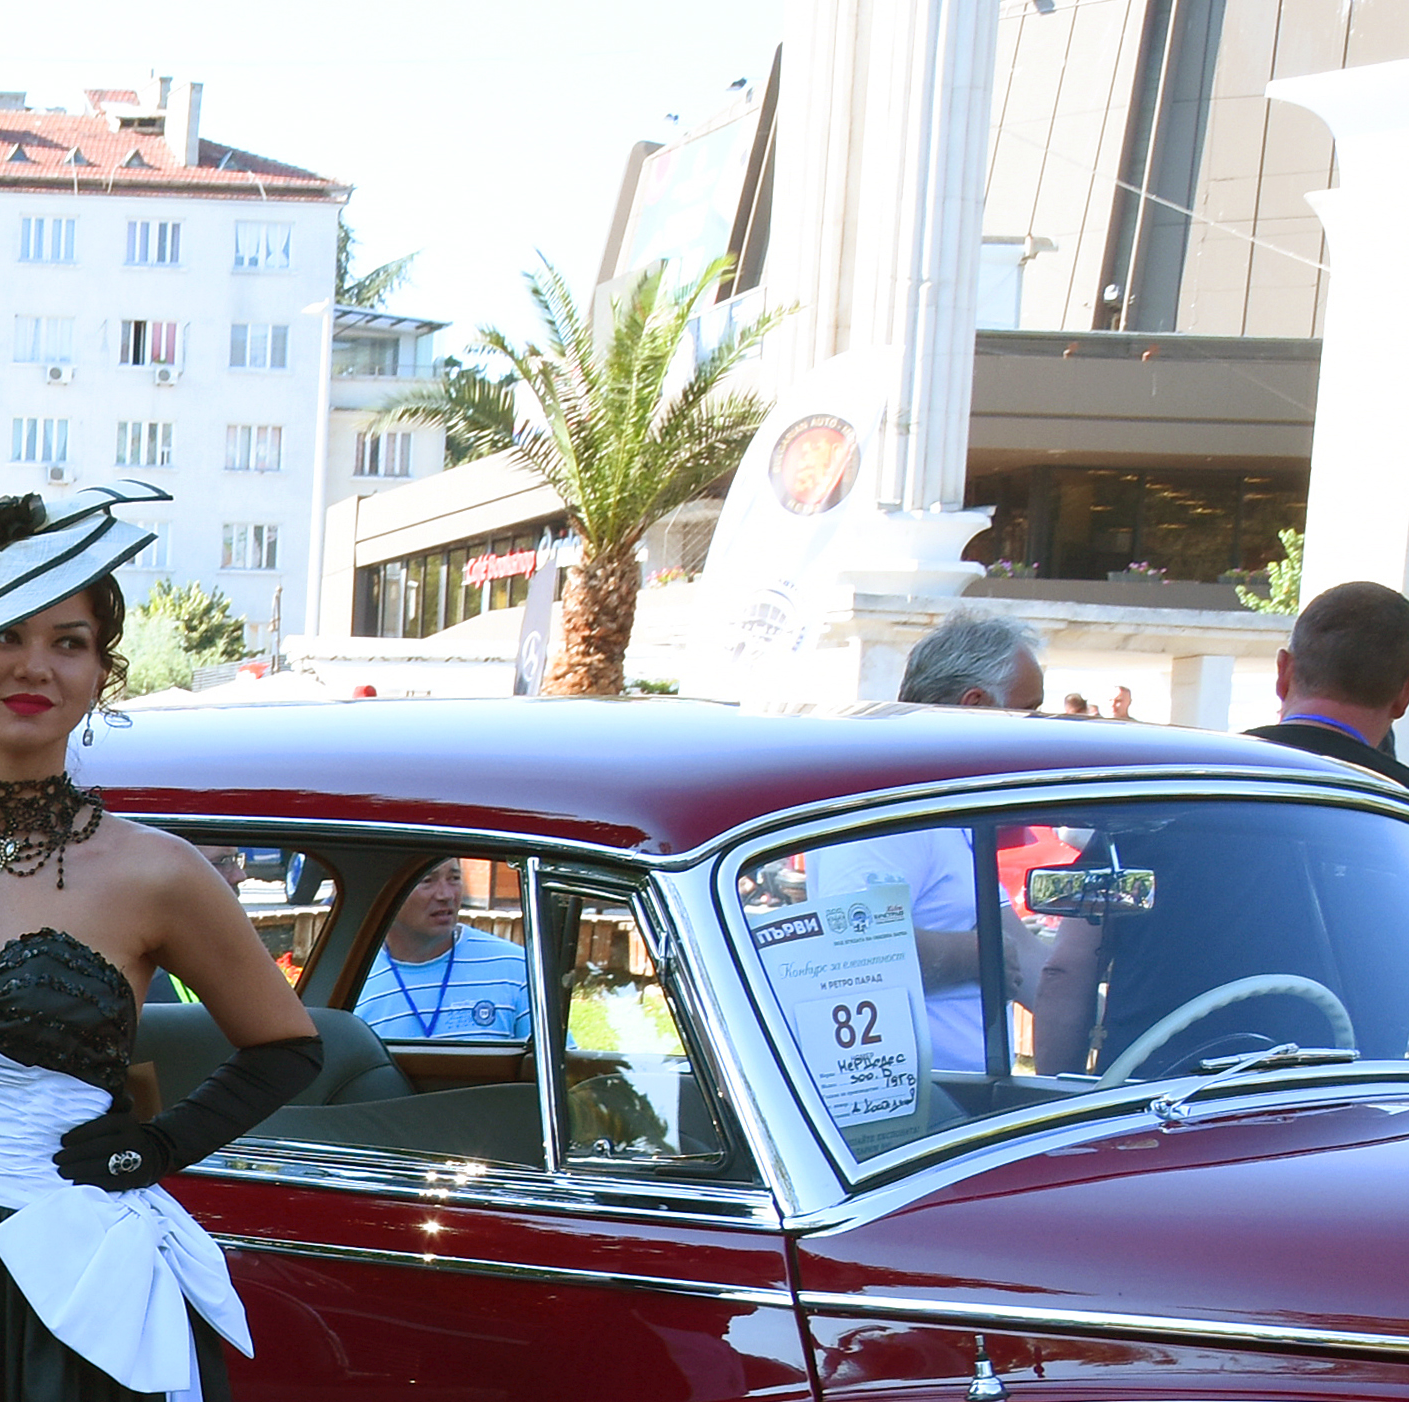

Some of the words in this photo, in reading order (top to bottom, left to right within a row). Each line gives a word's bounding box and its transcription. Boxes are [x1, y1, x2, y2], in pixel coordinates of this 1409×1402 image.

[755, 917, 820, 945] ПЪРВИ
[779, 961, 828, 980] Конкурс
[828, 977, 854, 990] РЕТРО
[855, 973, 884, 986] ПАРАД
[832, 1000, 883, 1049] 82
